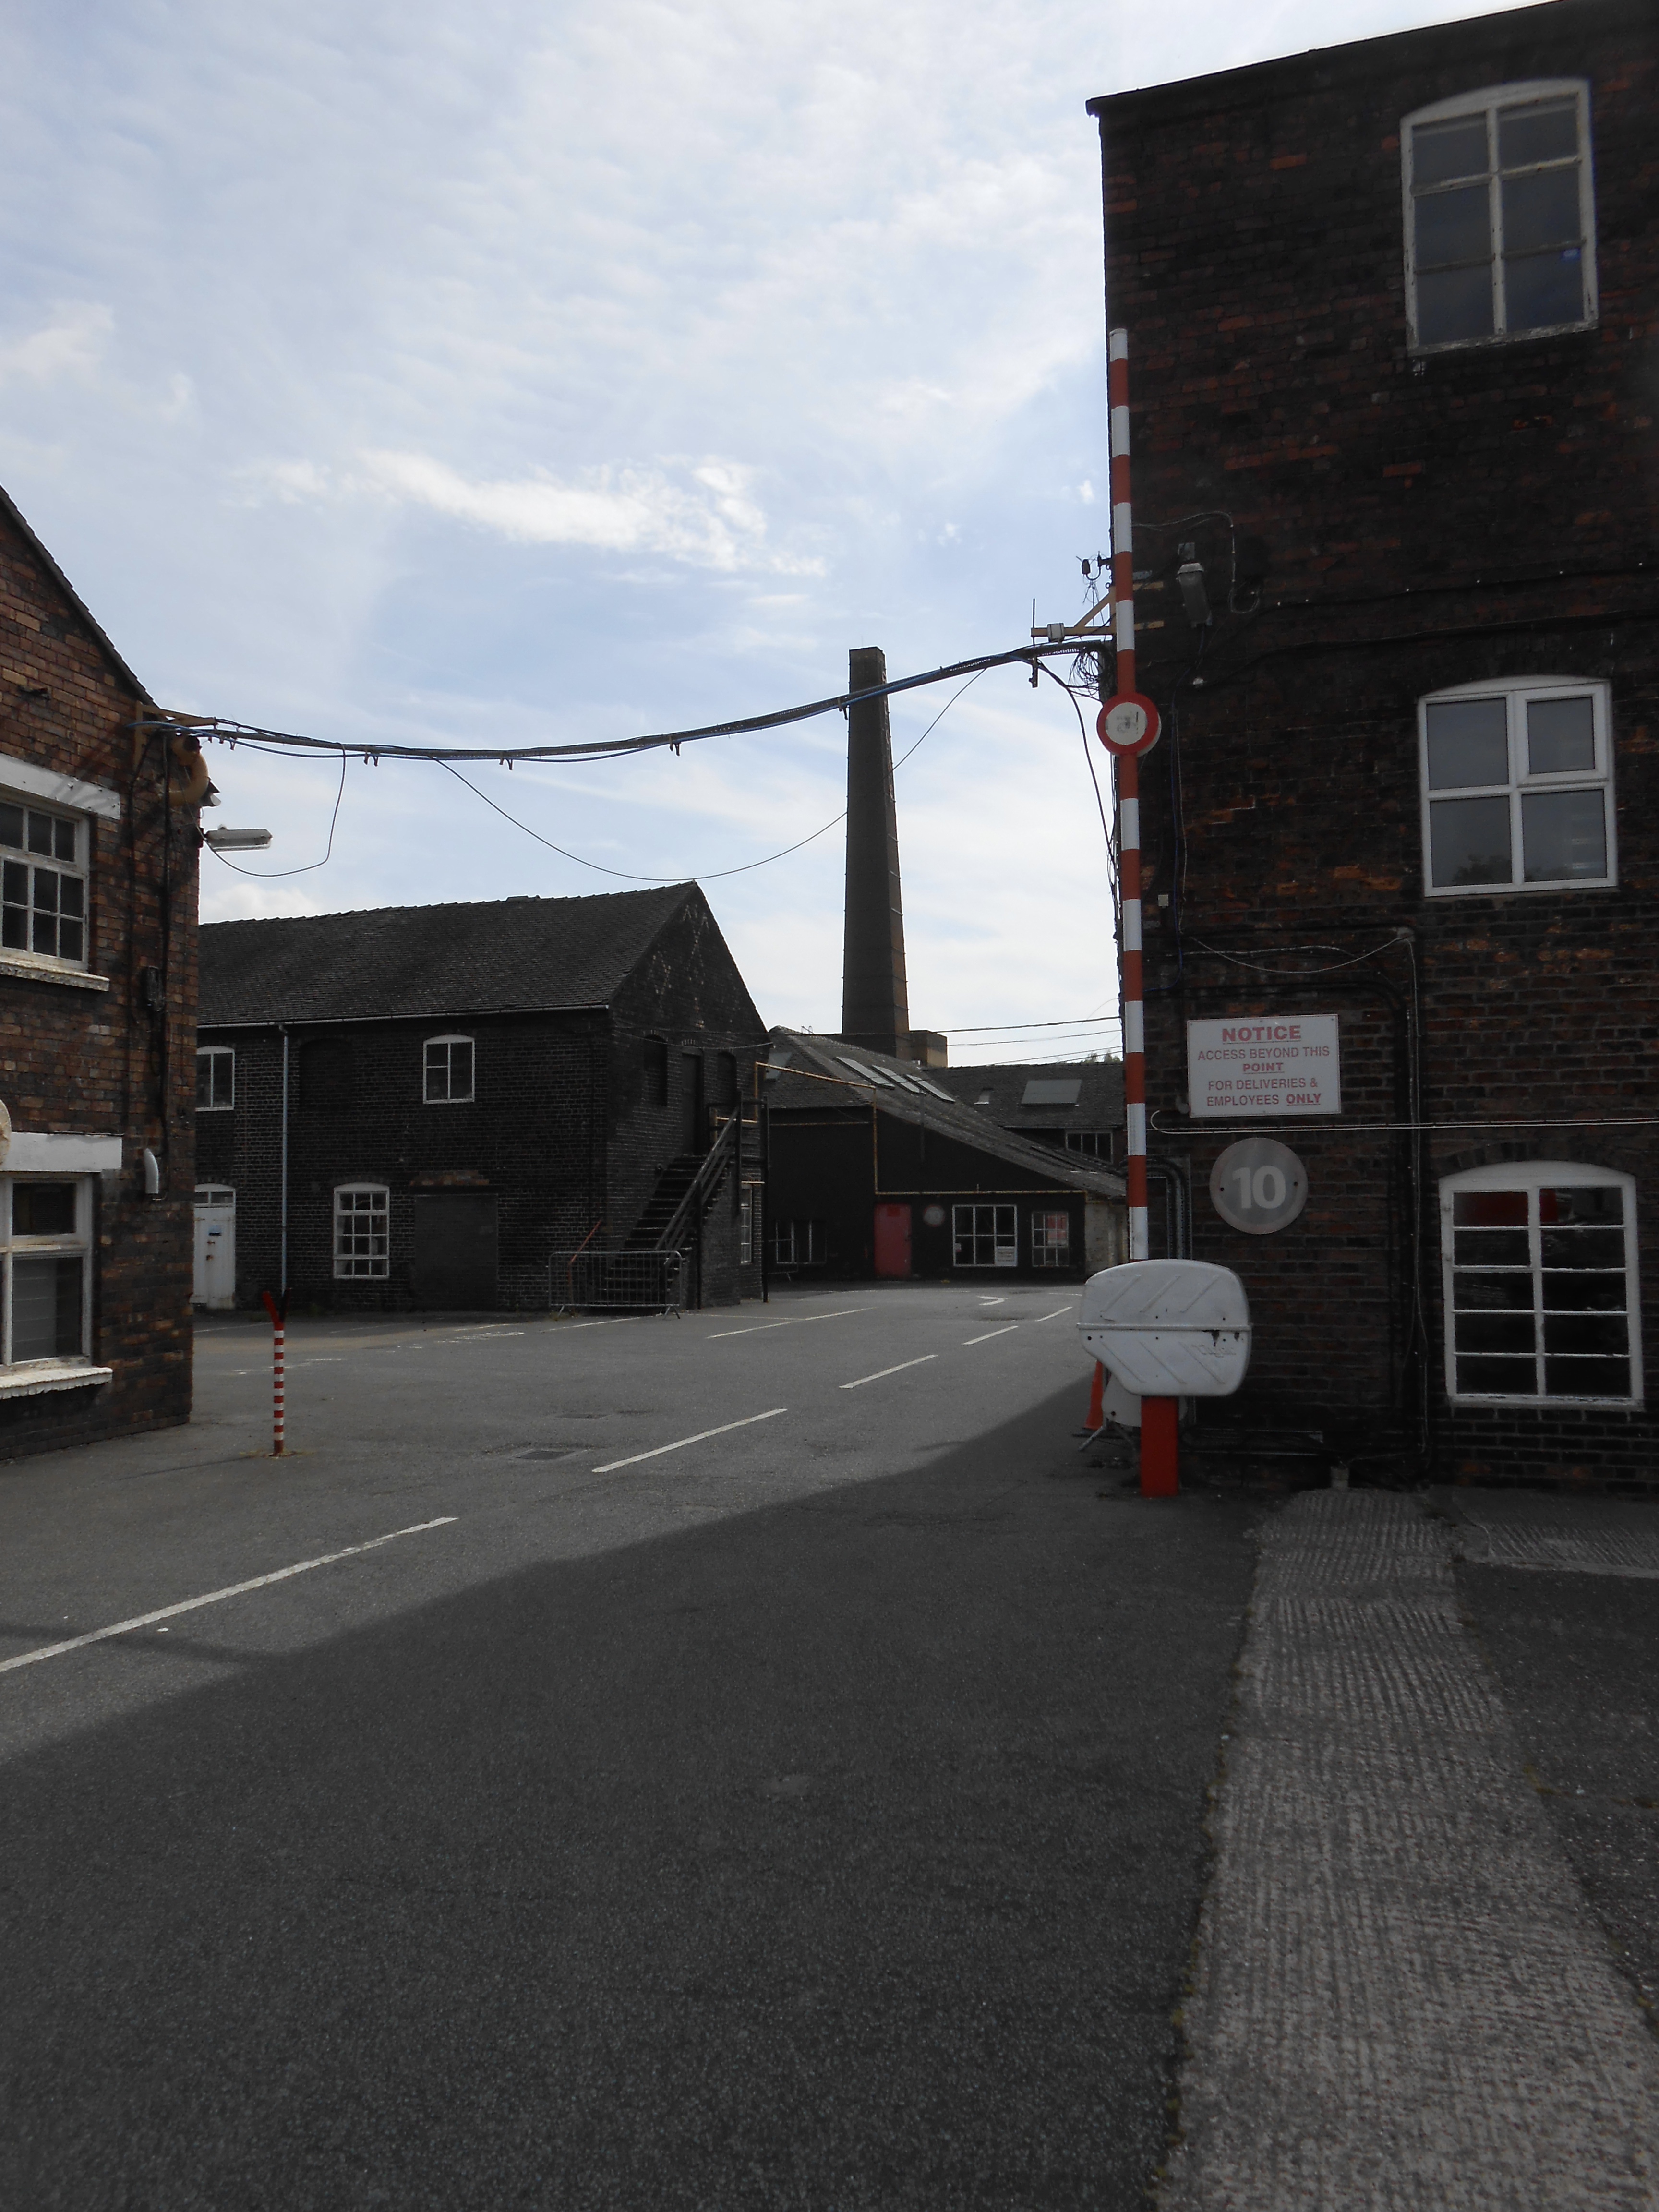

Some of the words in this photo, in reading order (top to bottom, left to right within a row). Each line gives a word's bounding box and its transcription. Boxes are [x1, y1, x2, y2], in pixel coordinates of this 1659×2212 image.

[1222, 1025, 1301, 1042] NOTICE
[1198, 1049, 1246, 1060] ACCESS
[1250, 1047, 1298, 1058] BEYOND
[1303, 1046, 1330, 1057] THIS
[1243, 1062, 1284, 1072] POINT
[1209, 1080, 1232, 1091] FOR
[1237, 1078, 1306, 1090] DELIVERIES
[1310, 1078, 1318, 1088] &
[1207, 1094, 1279, 1106] EMPLOYEES
[1286, 1093, 1322, 1104] ONLY
[1232, 1165, 1286, 1209] 10
